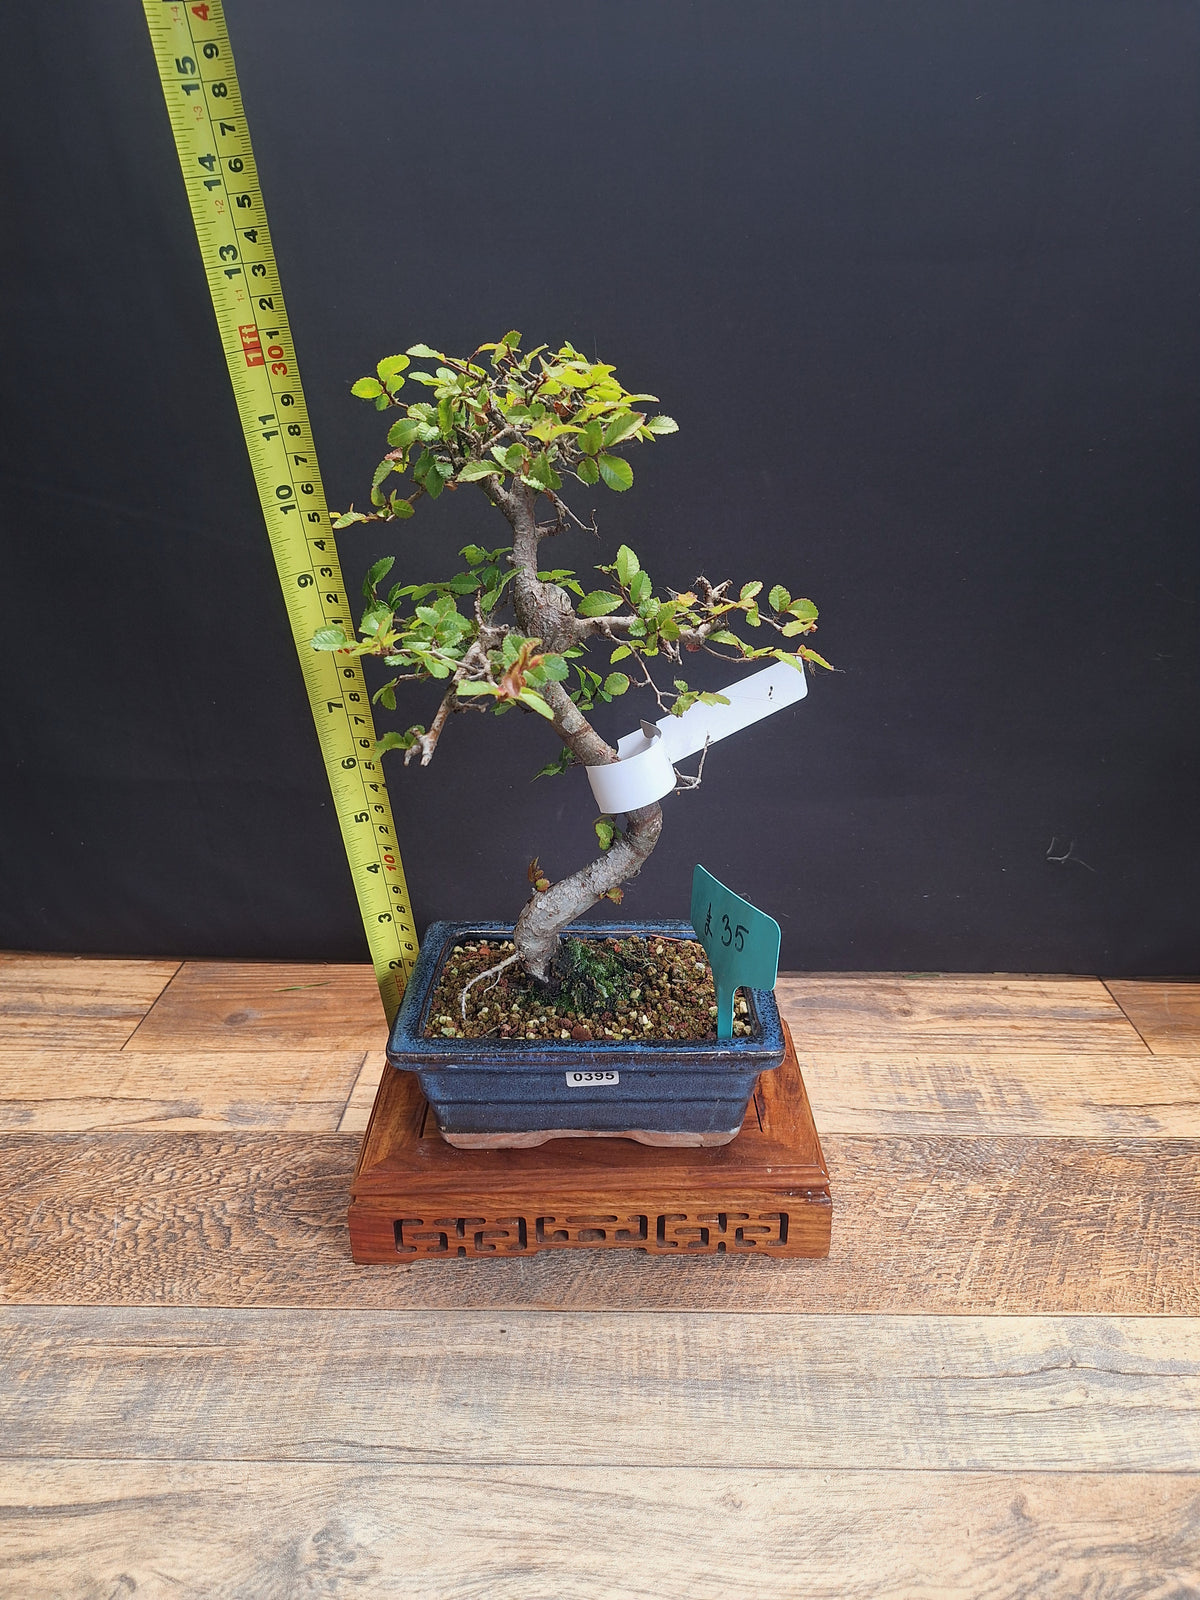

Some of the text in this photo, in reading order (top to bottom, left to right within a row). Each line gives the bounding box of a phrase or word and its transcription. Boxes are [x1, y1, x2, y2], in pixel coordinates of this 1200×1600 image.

[203, 42, 219, 59] 9
[174, 56, 200, 96] 15
[211, 82, 228, 98] 8
[219, 122, 236, 136] 7
[228, 157, 244, 173] 6
[197, 153, 222, 192] 14
[236, 194, 252, 208] 5
[243, 229, 258, 243] 4
[218, 244, 242, 280] 13
[251, 263, 267, 277] 3
[258, 297, 274, 311] 2
[265, 330, 280, 340] 1
[267, 345, 288, 376] 30
[281, 393, 295, 407] 9
[258, 413, 279, 441] 11
[287, 424, 302, 436] 8
[293, 454, 308, 466] 7
[300, 483, 314, 495] 6
[275, 484, 296, 515] 10
[307, 511, 321, 523] 5
[313, 539, 326, 551] 4
[320, 567, 333, 578] 3
[297, 573, 314, 588] 9
[325, 593, 339, 604] 2
[343, 668, 355, 679] 9
[349, 692, 361, 703] 8
[327, 701, 344, 714] 7
[353, 716, 366, 725] 7
[359, 739, 371, 749] 6
[341, 757, 357, 770] 6
[364, 761, 375, 771] 5
[369, 783, 380, 793] 4
[374, 804, 385, 814] 3
[354, 811, 370, 823] 5
[378, 825, 389, 835] 2
[366, 863, 381, 874] 4
[383, 854, 397, 872] 10
[392, 885, 402, 894] 9
[396, 905, 406, 914] 8
[377, 912, 393, 924] 3
[400, 924, 410, 932] 7
[404, 942, 414, 951] 6
[388, 959, 403, 970] 2
[573, 1072, 615, 1081] 0395
